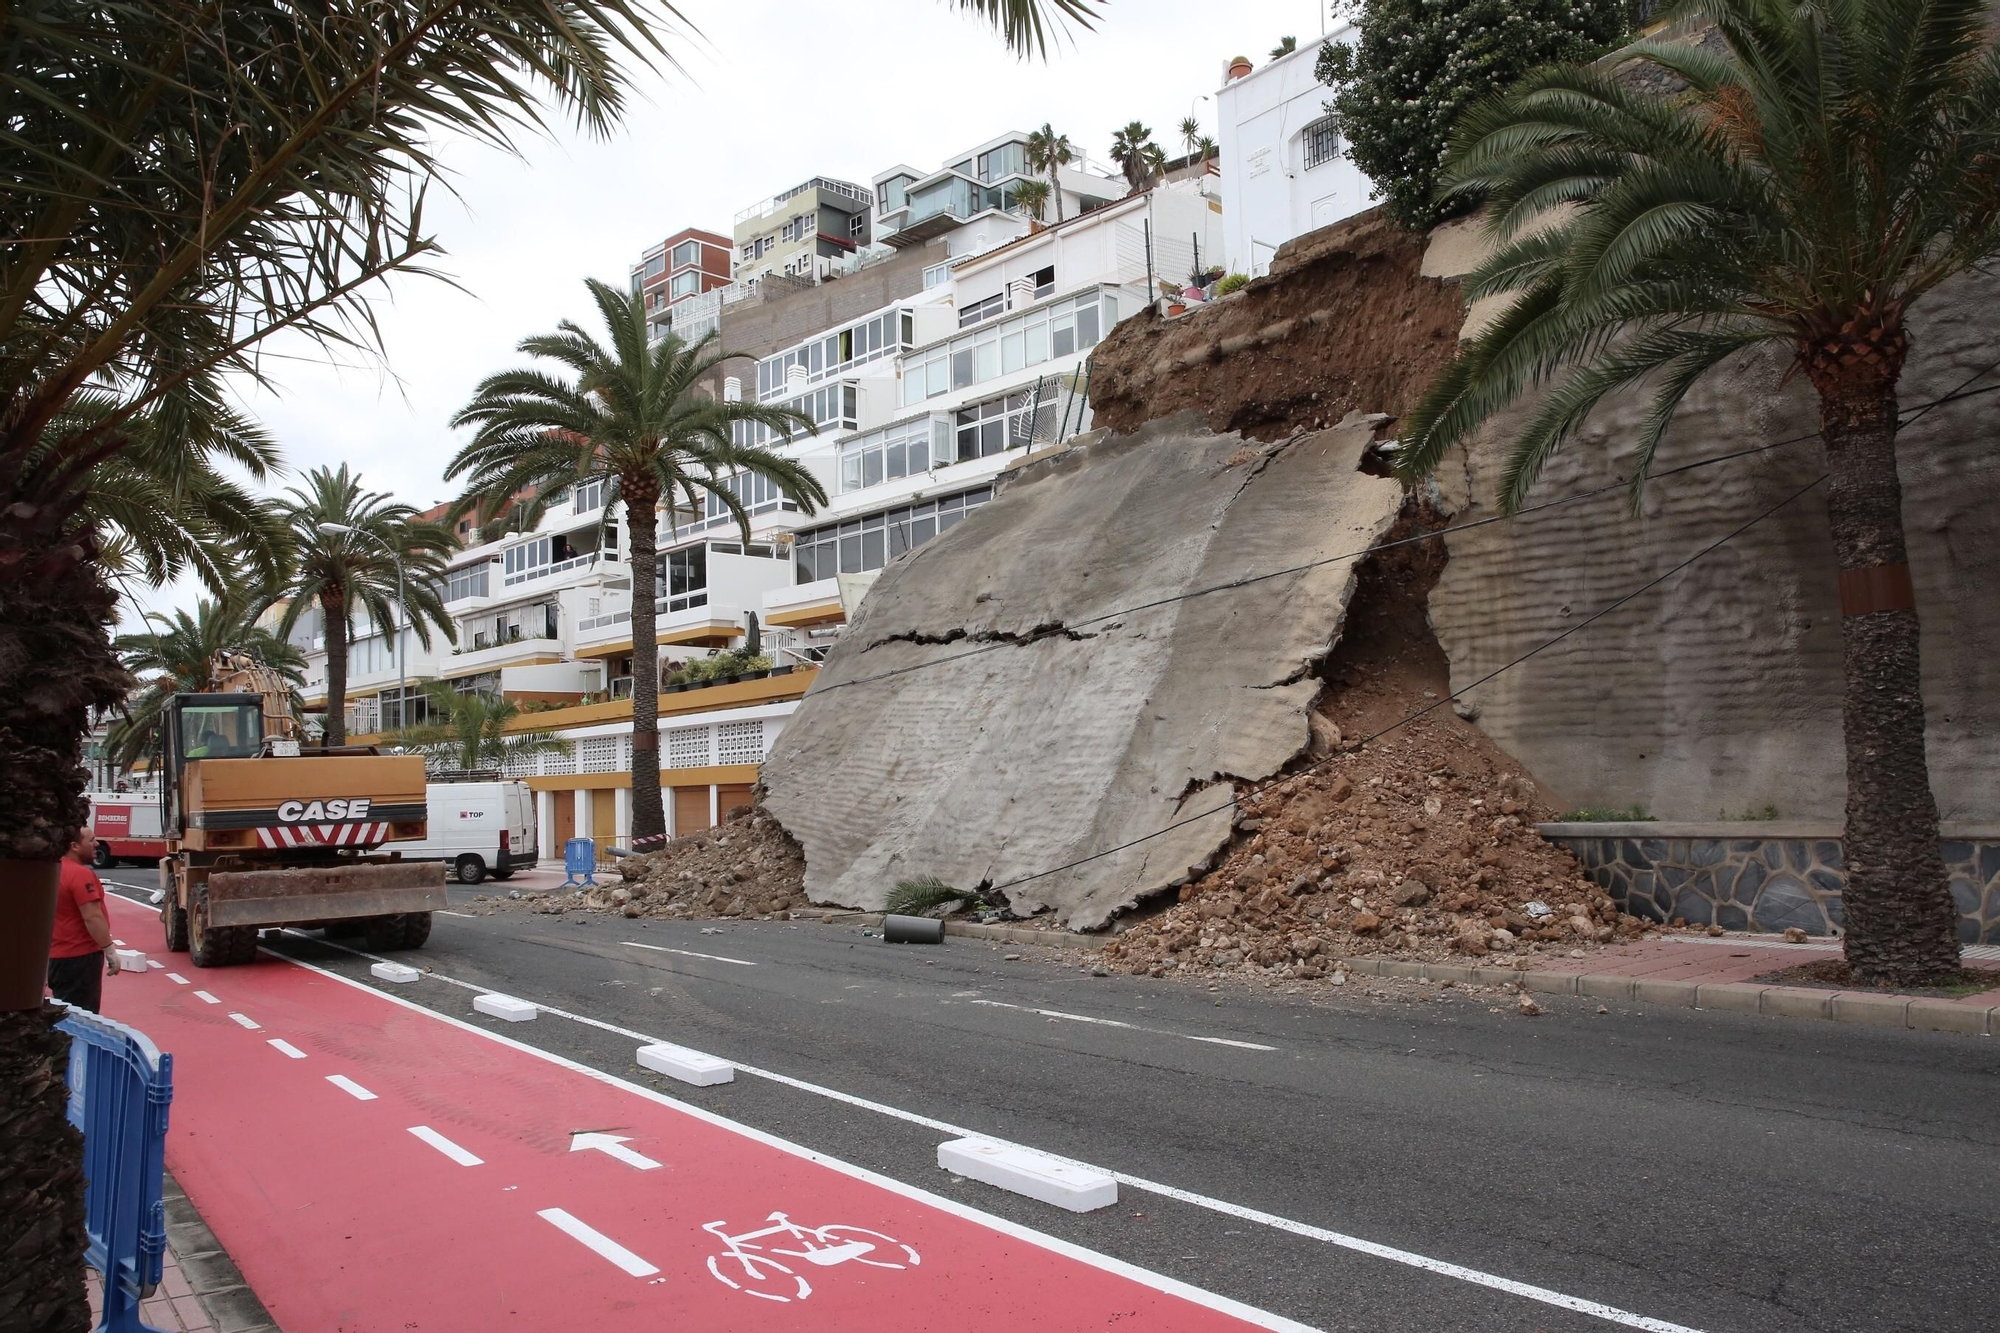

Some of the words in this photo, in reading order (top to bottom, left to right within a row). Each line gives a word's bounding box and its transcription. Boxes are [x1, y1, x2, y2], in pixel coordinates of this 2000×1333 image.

[277, 799, 371, 822] CASE
[97, 814, 128, 822] BOMBEROS
[468, 811, 484, 819] TOP
